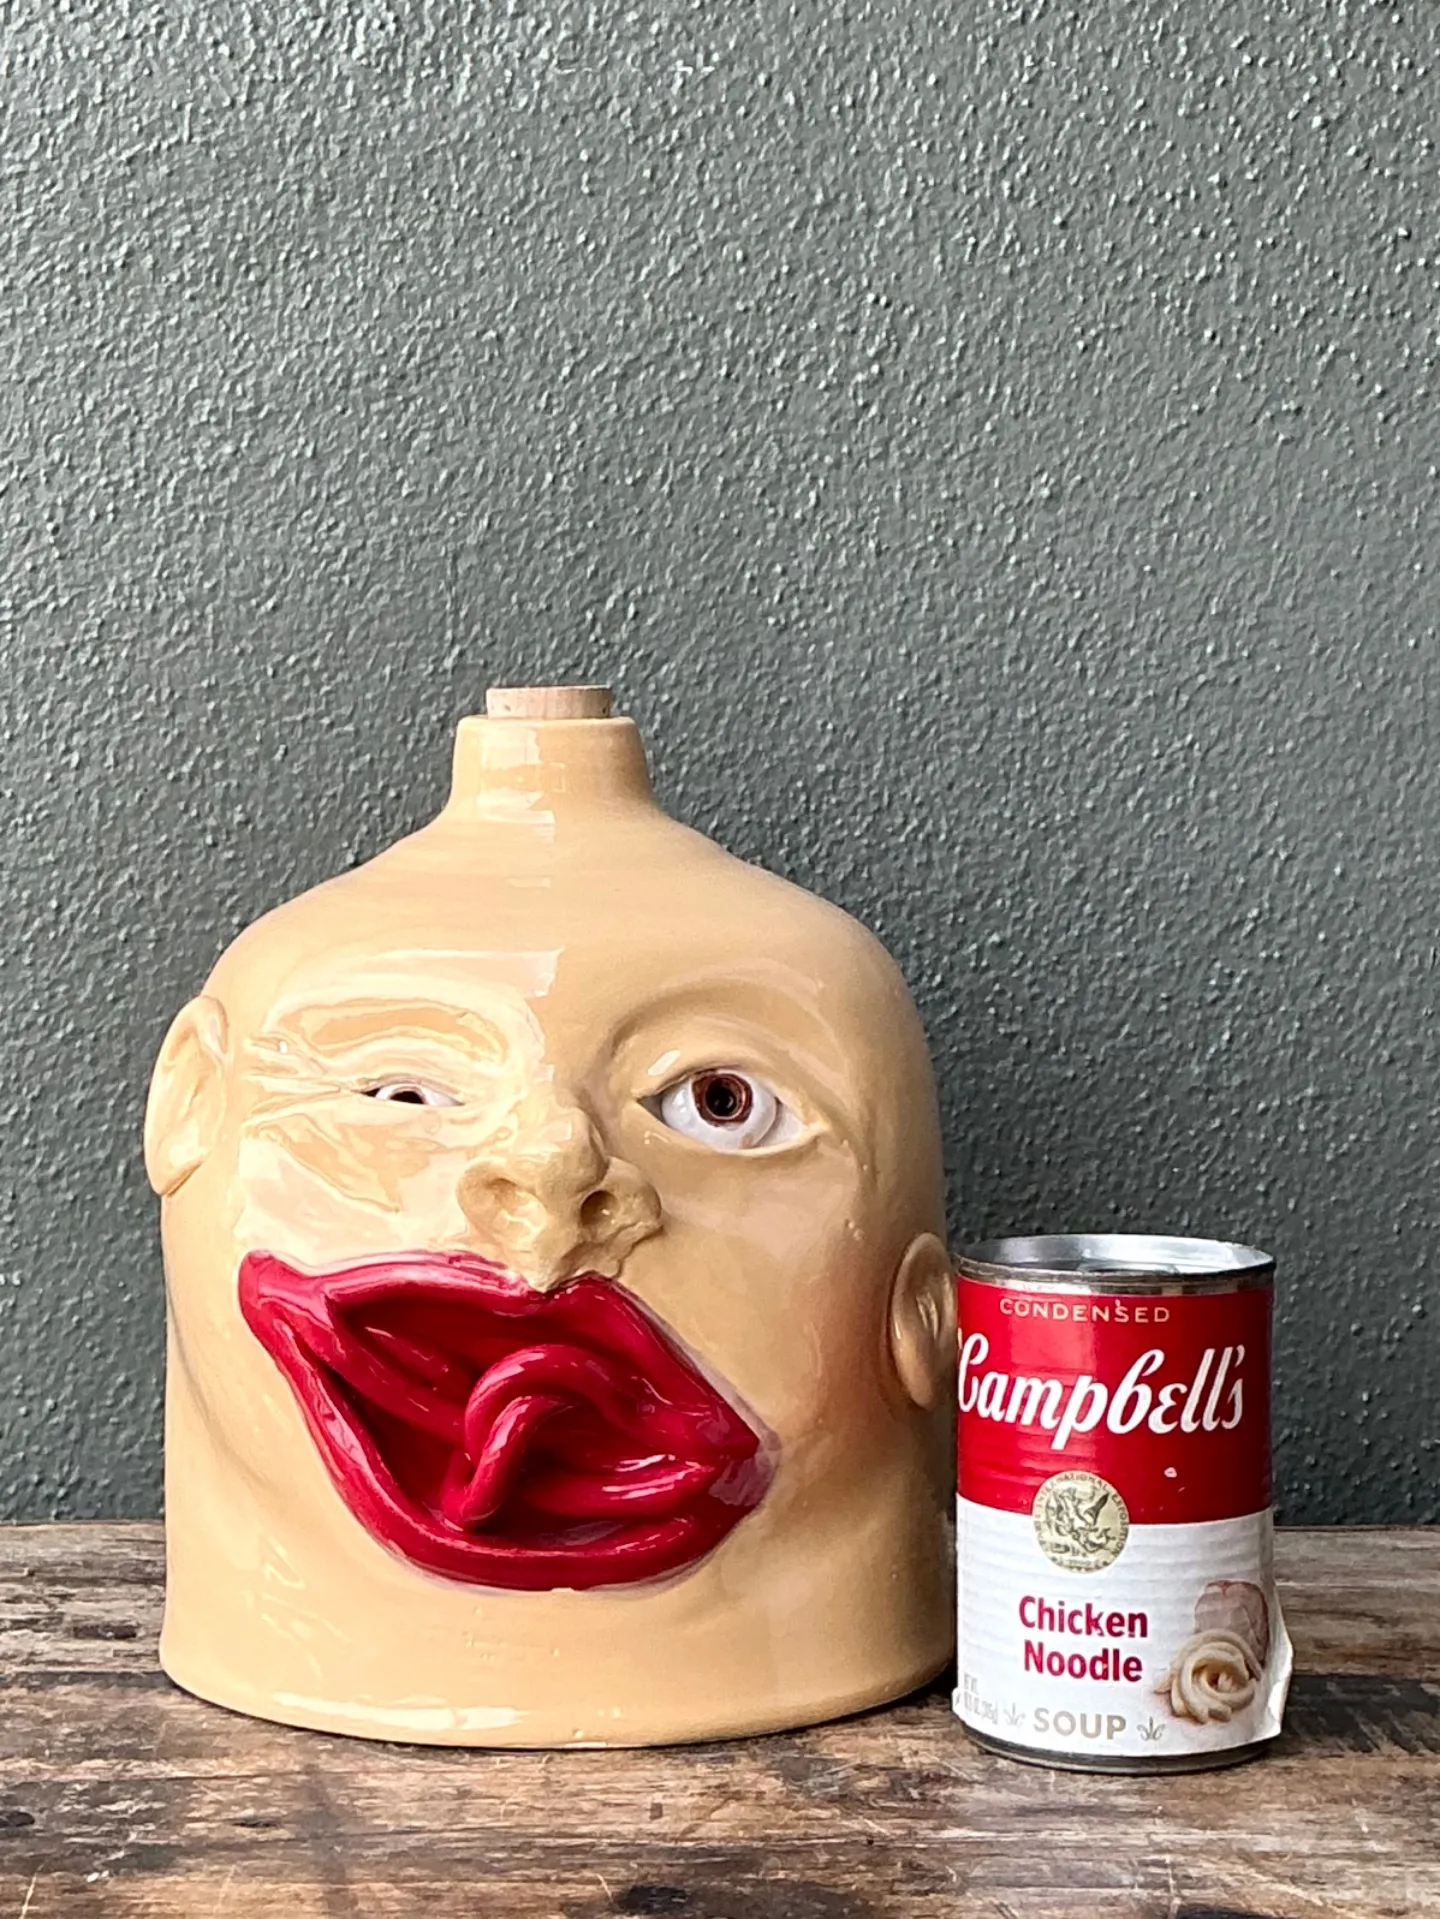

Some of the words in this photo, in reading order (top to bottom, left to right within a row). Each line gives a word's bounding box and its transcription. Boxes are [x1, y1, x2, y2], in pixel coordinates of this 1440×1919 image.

[1000, 1298, 1170, 1324] CONDENSED
[957, 1333, 1246, 1451] Campbell's
[1018, 1595, 1149, 1639] Chicken
[1023, 1639, 1144, 1683] Noodle
[1033, 1707, 1127, 1741] SOUP
